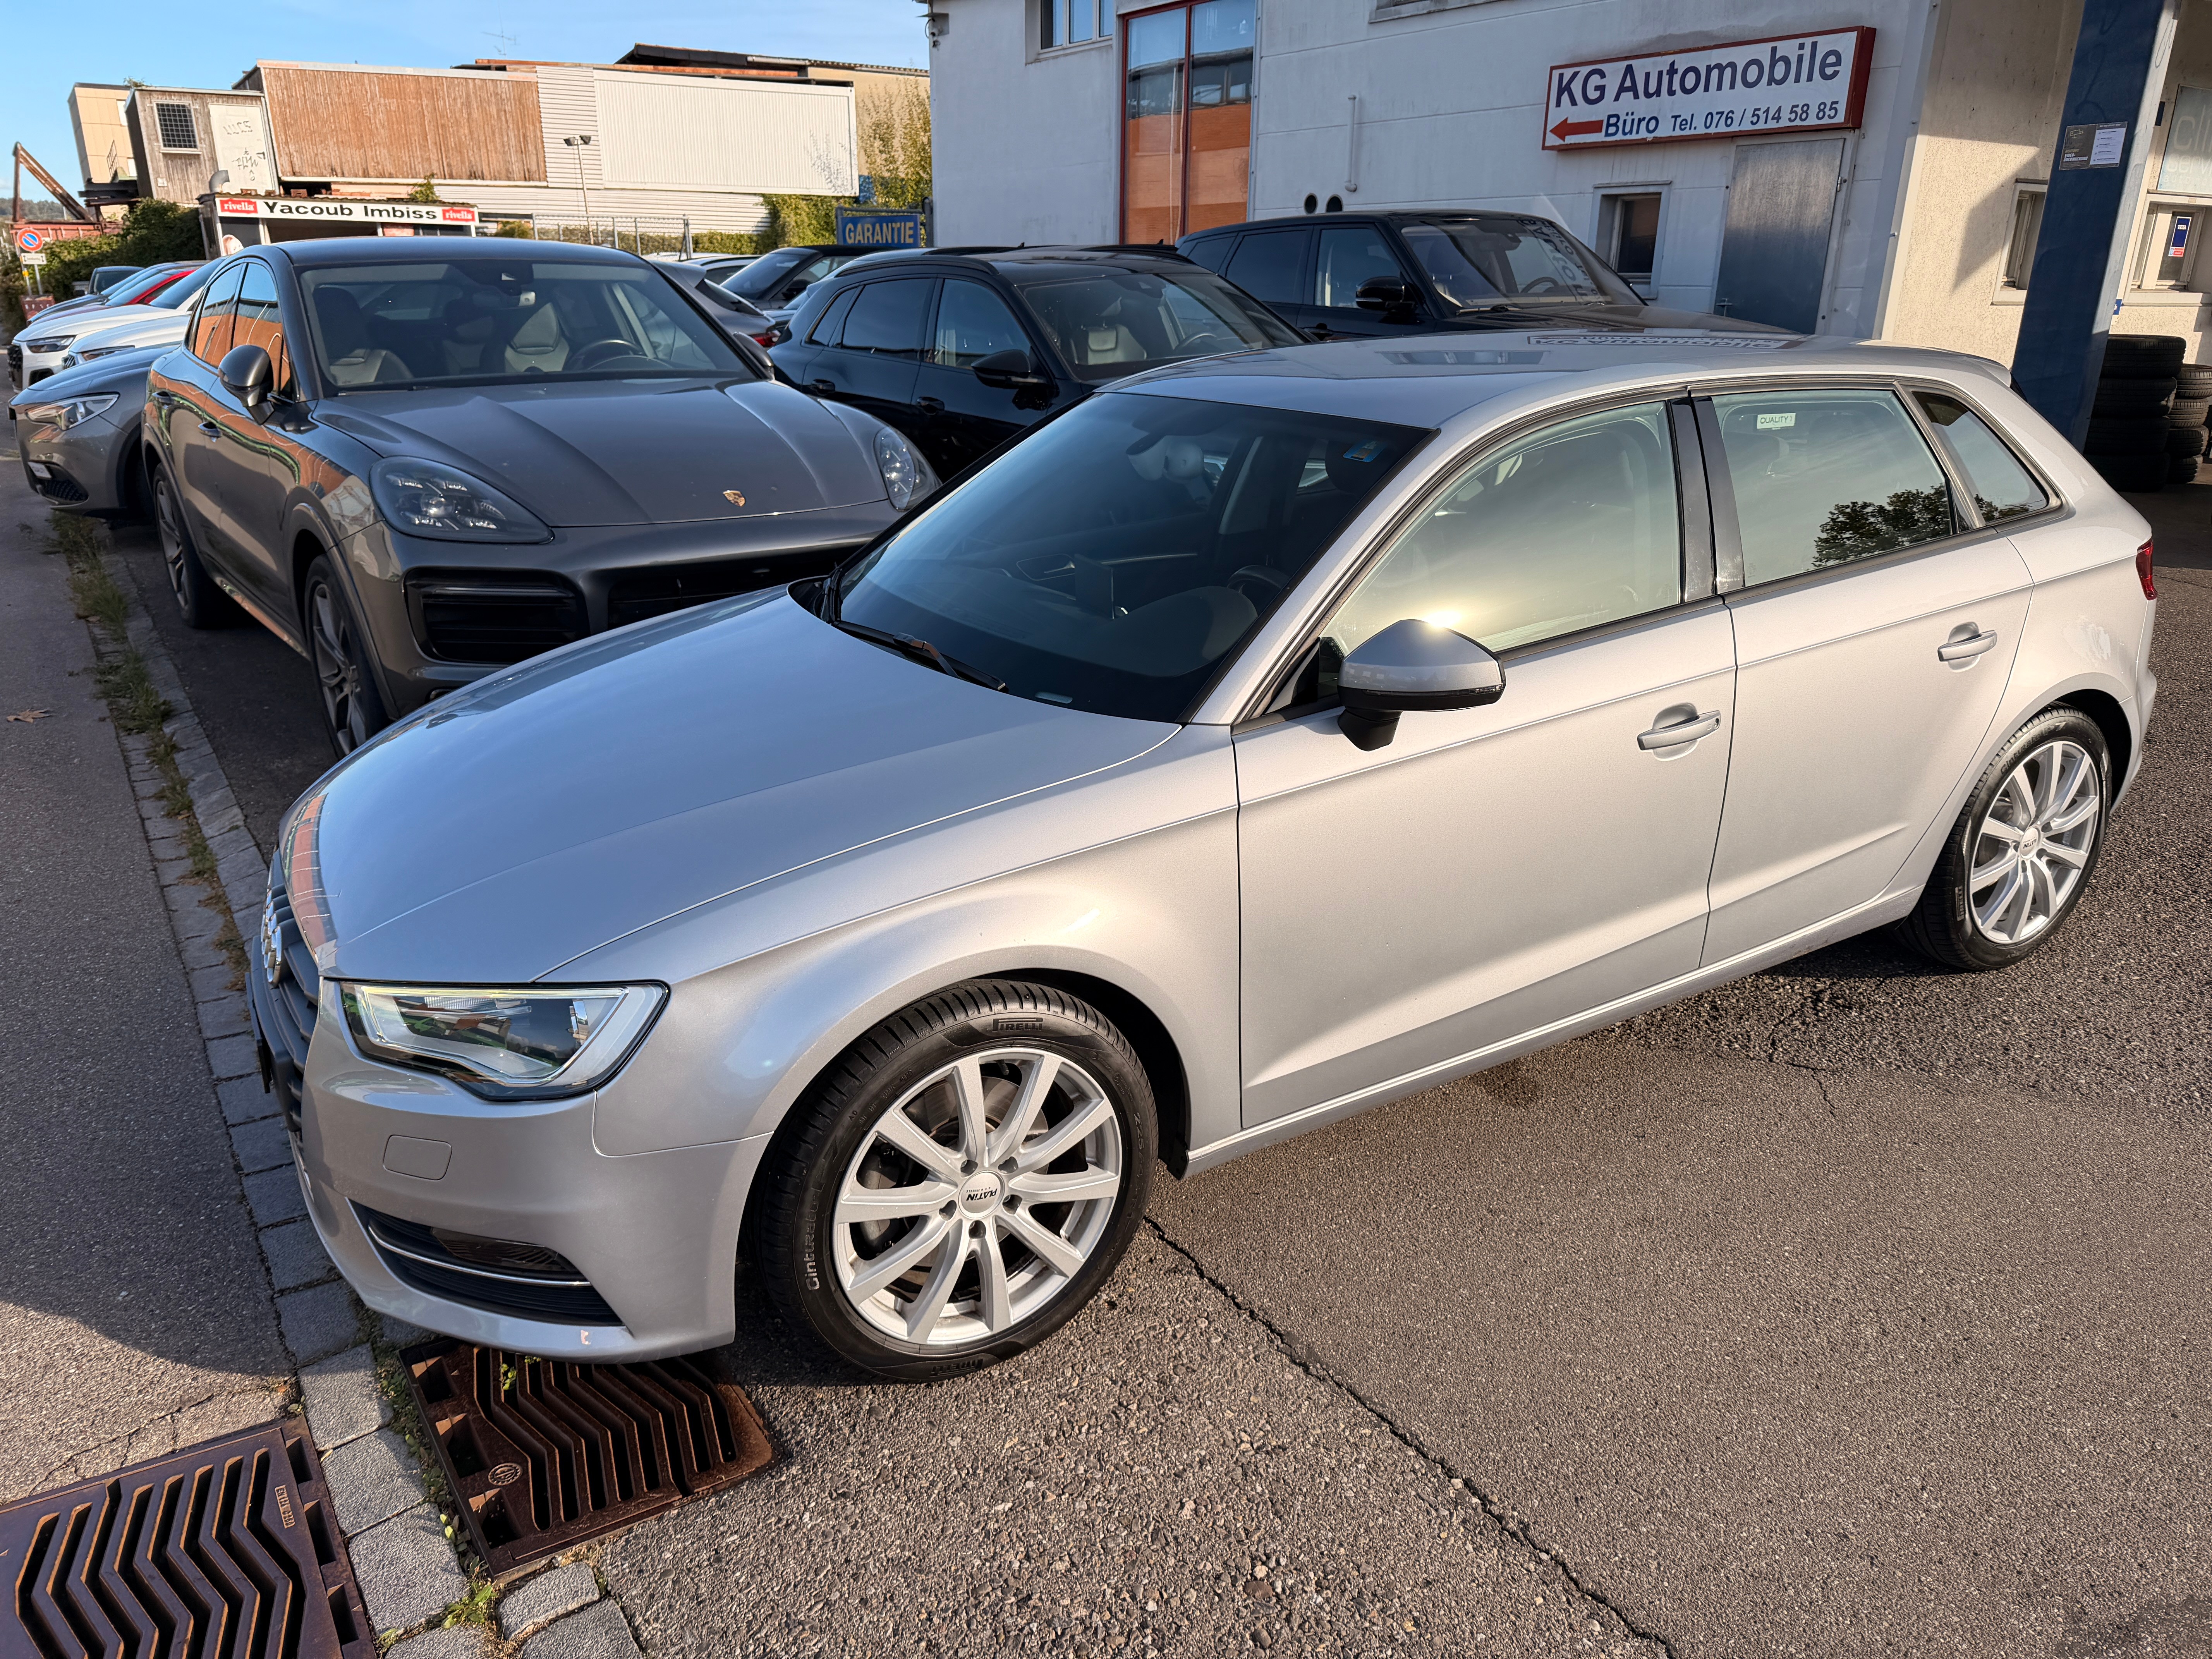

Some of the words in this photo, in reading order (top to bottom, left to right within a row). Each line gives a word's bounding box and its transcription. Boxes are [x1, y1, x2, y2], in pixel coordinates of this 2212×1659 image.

[1555, 68, 1606, 108] KG
[1613, 41, 1842, 102] Automobile
[1604, 111, 1659, 137] Büro
[1671, 113, 1697, 132] Tel.
[1704, 110, 1735, 129] 076
[1750, 105, 1782, 125] 514
[1788, 103, 1810, 123] 58
[1816, 101, 1839, 120] 85
[223, 199, 255, 211] rivella
[263, 201, 353, 216] Yacoub
[364, 205, 437, 220] Imbiss
[445, 210, 473, 220] rivella
[845, 222, 914, 244] GARANTIE
[992, 1017, 1044, 1032] PIRELLI
